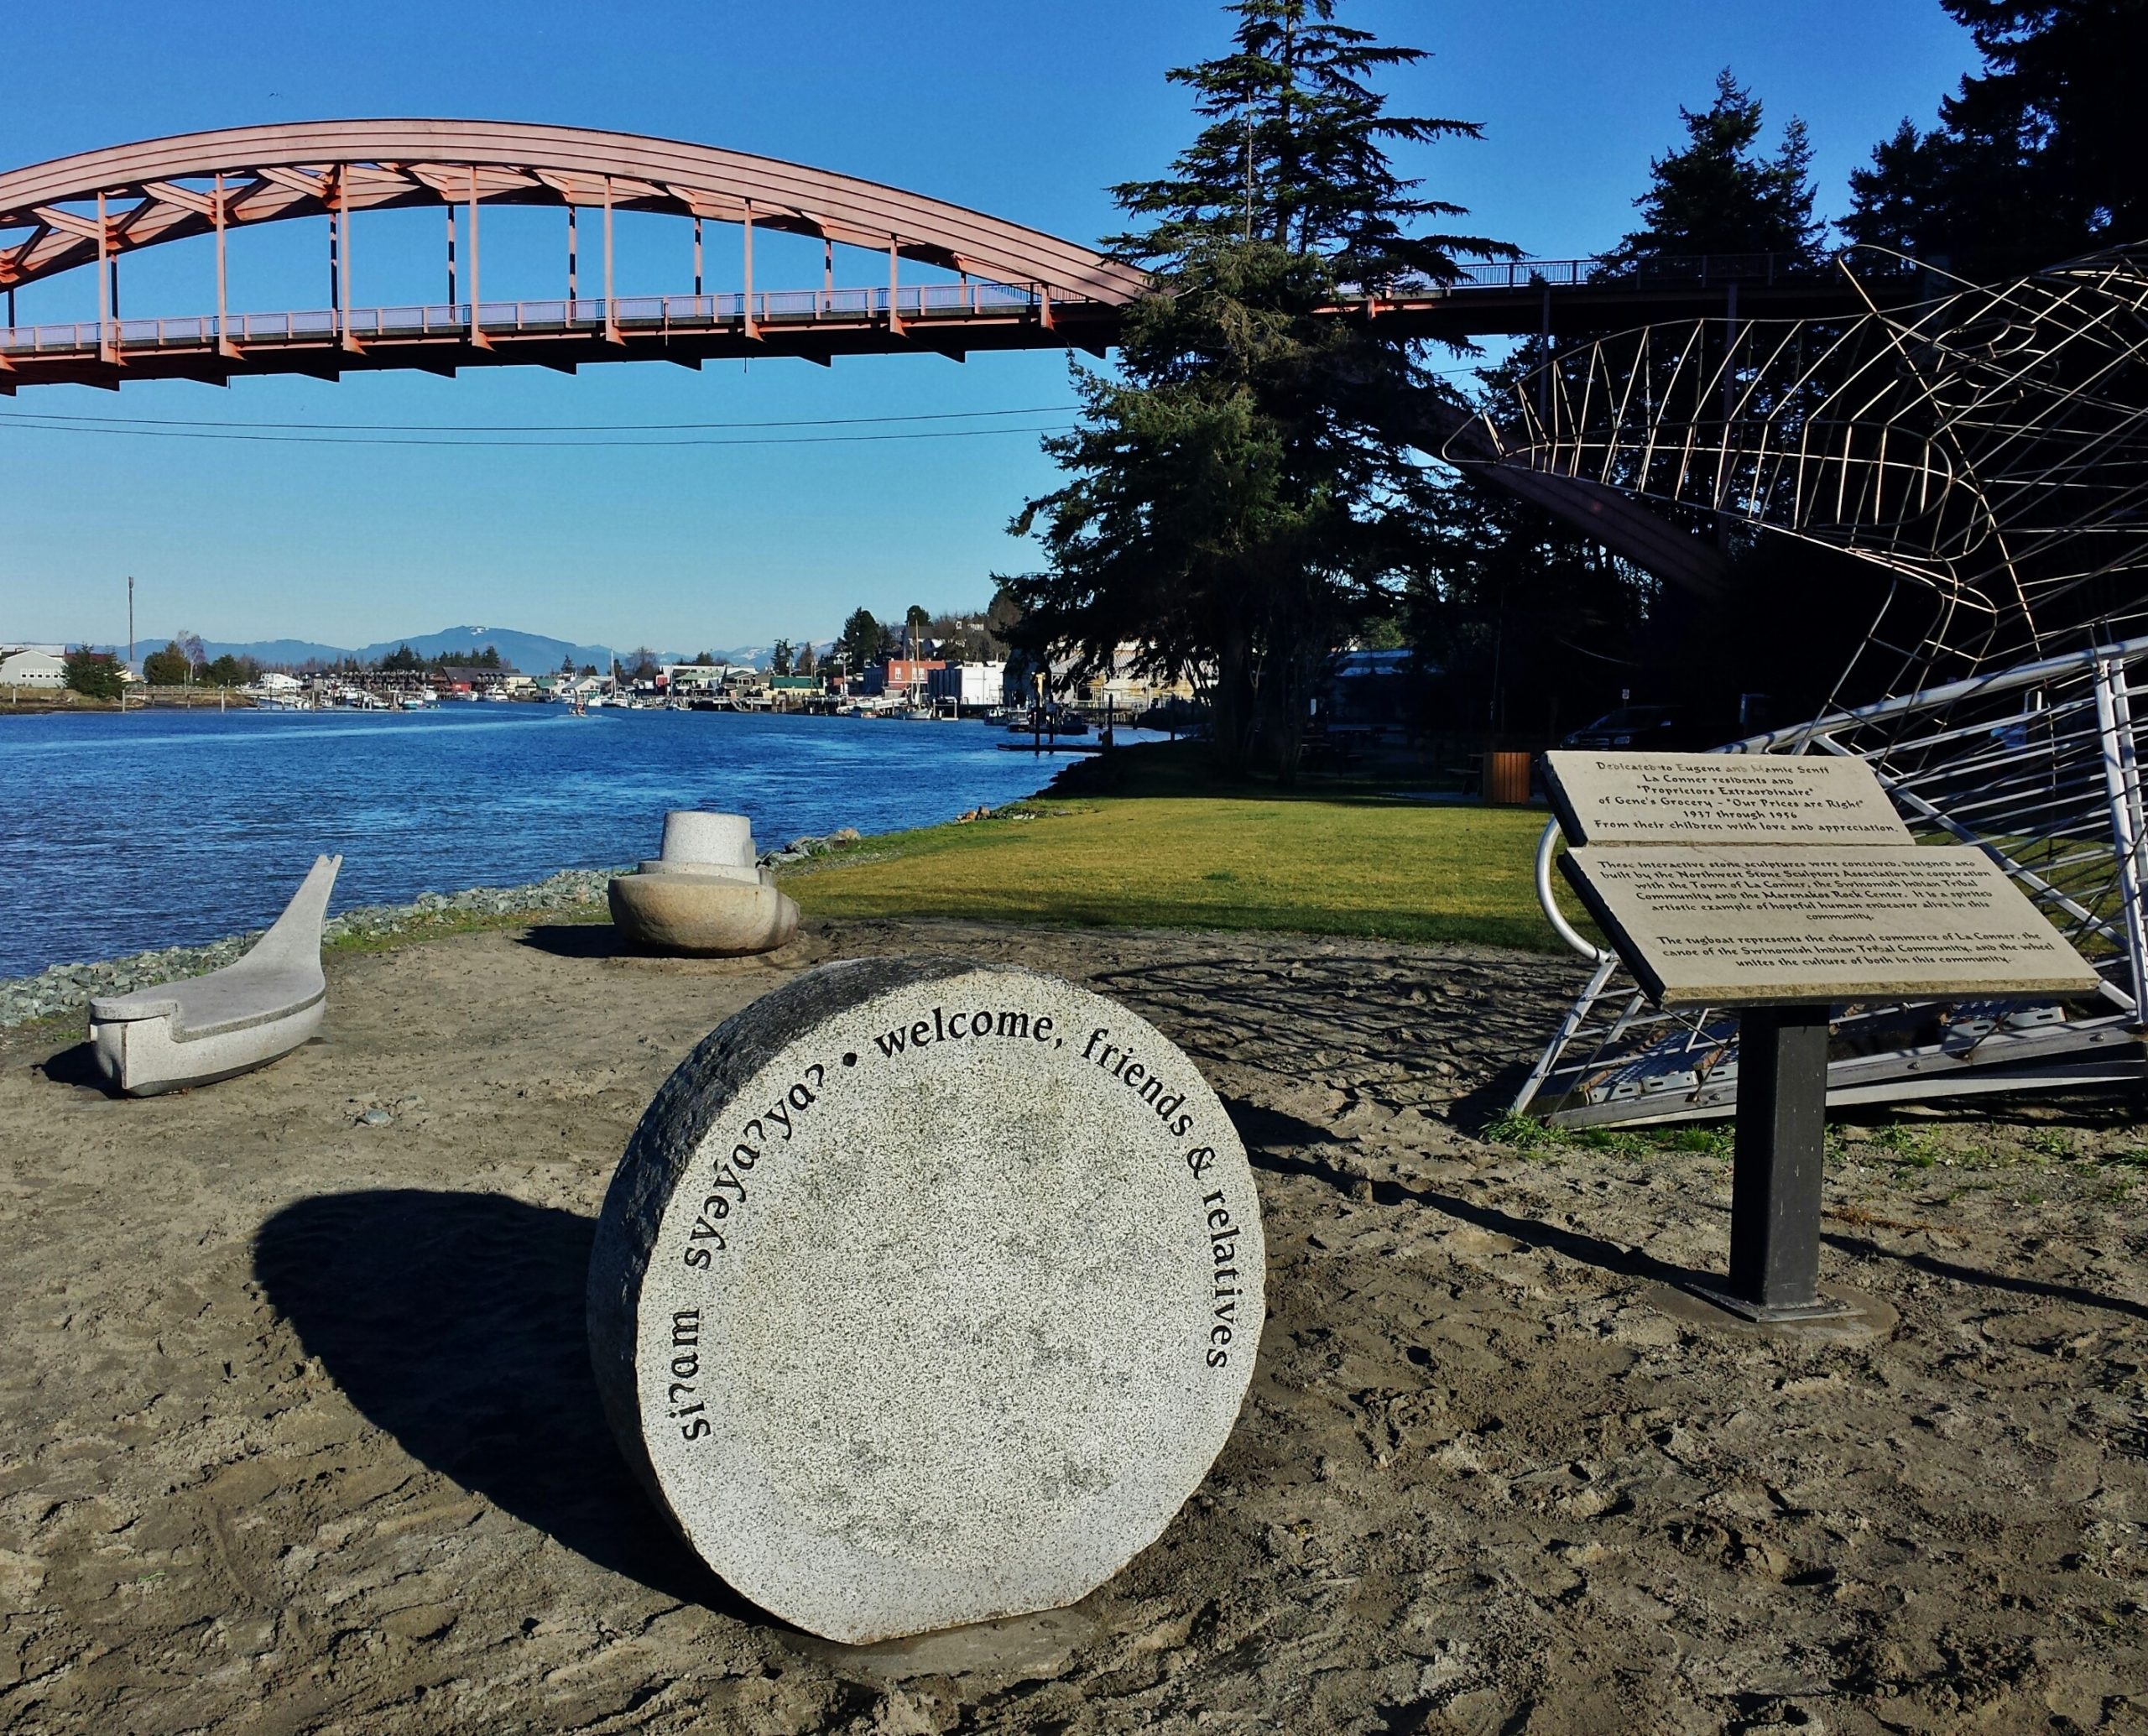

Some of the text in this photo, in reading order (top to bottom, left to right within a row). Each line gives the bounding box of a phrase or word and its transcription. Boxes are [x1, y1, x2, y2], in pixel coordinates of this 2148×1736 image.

[1596, 762, 1656, 770] Dedicated
[1676, 764, 1721, 773] Eugene
[1599, 796, 1610, 805] of
[1661, 798, 1713, 808] Grocery
[1717, 811, 1765, 820] through
[1634, 821, 1665, 829] their
[1670, 821, 1722, 830] children
[1727, 821, 1756, 831] with
[1760, 822, 1786, 831] love
[1598, 861, 1634, 869] These
[1634, 871, 1651, 880] by
[1786, 871, 1839, 879] Sculptors
[1926, 870, 1991, 878] cooperation
[1702, 903, 1752, 912] example
[1686, 936, 1734, 946] tugboat
[1718, 947, 1739, 956] the
[1741, 946, 1812, 955] Swinomish
[1815, 946, 1855, 954] Indian
[1803, 957, 1848, 966] culture
[1939, 956, 2011, 964] community.
[873, 1007, 1065, 1059] welcome,
[1080, 1027, 1195, 1138] friends
[1186, 1146, 1216, 1180] &
[1202, 1188, 1243, 1368] relatives
